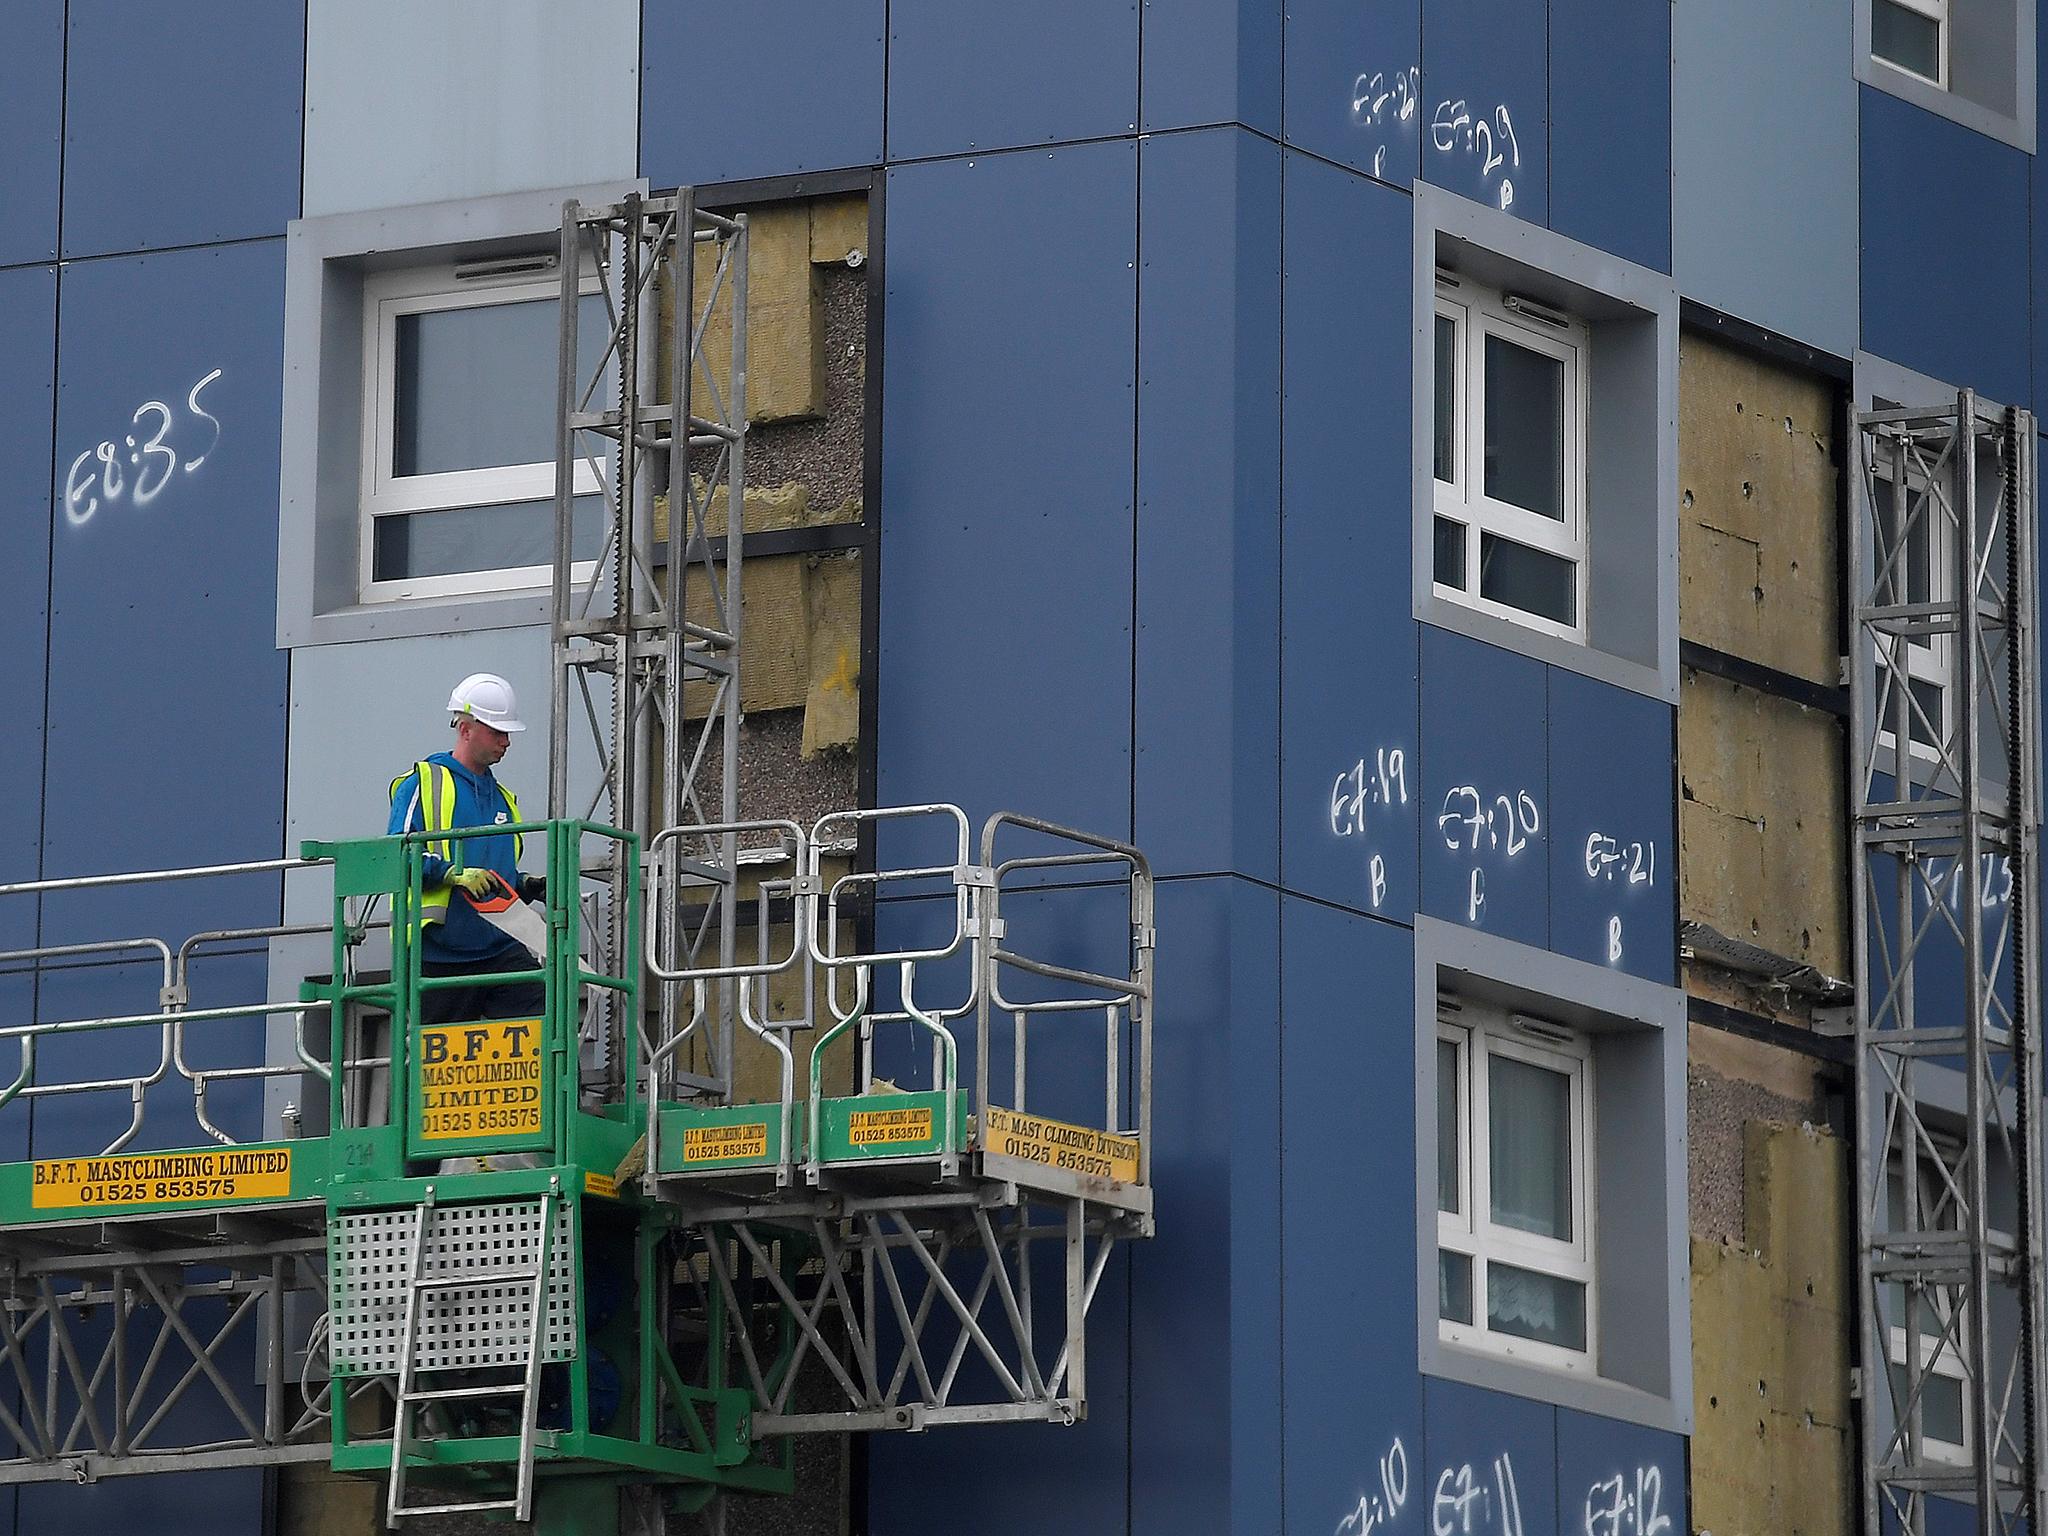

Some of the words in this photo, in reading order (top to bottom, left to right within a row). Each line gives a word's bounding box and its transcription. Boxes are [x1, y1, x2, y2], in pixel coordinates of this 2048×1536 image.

[1431, 100, 1519, 176] E7:29
[1331, 747, 1407, 836] E7:19
[1439, 785, 1539, 856] E7:20
[1585, 832, 1655, 886] E7:21
[1609, 915, 1623, 962] B
[422, 1025, 540, 1065] B.F.T.
[422, 1061, 540, 1088] MASTCLIMBING
[423, 1086, 539, 1110] LIMITED
[422, 1112, 472, 1133] 01525
[478, 1107, 539, 1130] 853575
[854, 1128, 885, 1142] 01525
[888, 1126, 926, 1140] 853575
[1011, 1117, 1042, 1140] MAST
[1044, 1125, 1095, 1151] CLIMBING
[34, 1163, 81, 1185] B.F.T.
[87, 1156, 214, 1183] MASTCLIMBING
[218, 1151, 289, 1176] LIMITED
[688, 1145, 720, 1159] 01525
[722, 1142, 761, 1156] 853575
[1005, 1138, 1051, 1164] 01525
[1056, 1150, 1112, 1178] 853575
[80, 1183, 147, 1202] 01525
[155, 1178, 235, 1198] 853575
[1585, 1465, 1671, 1536] E7:12
